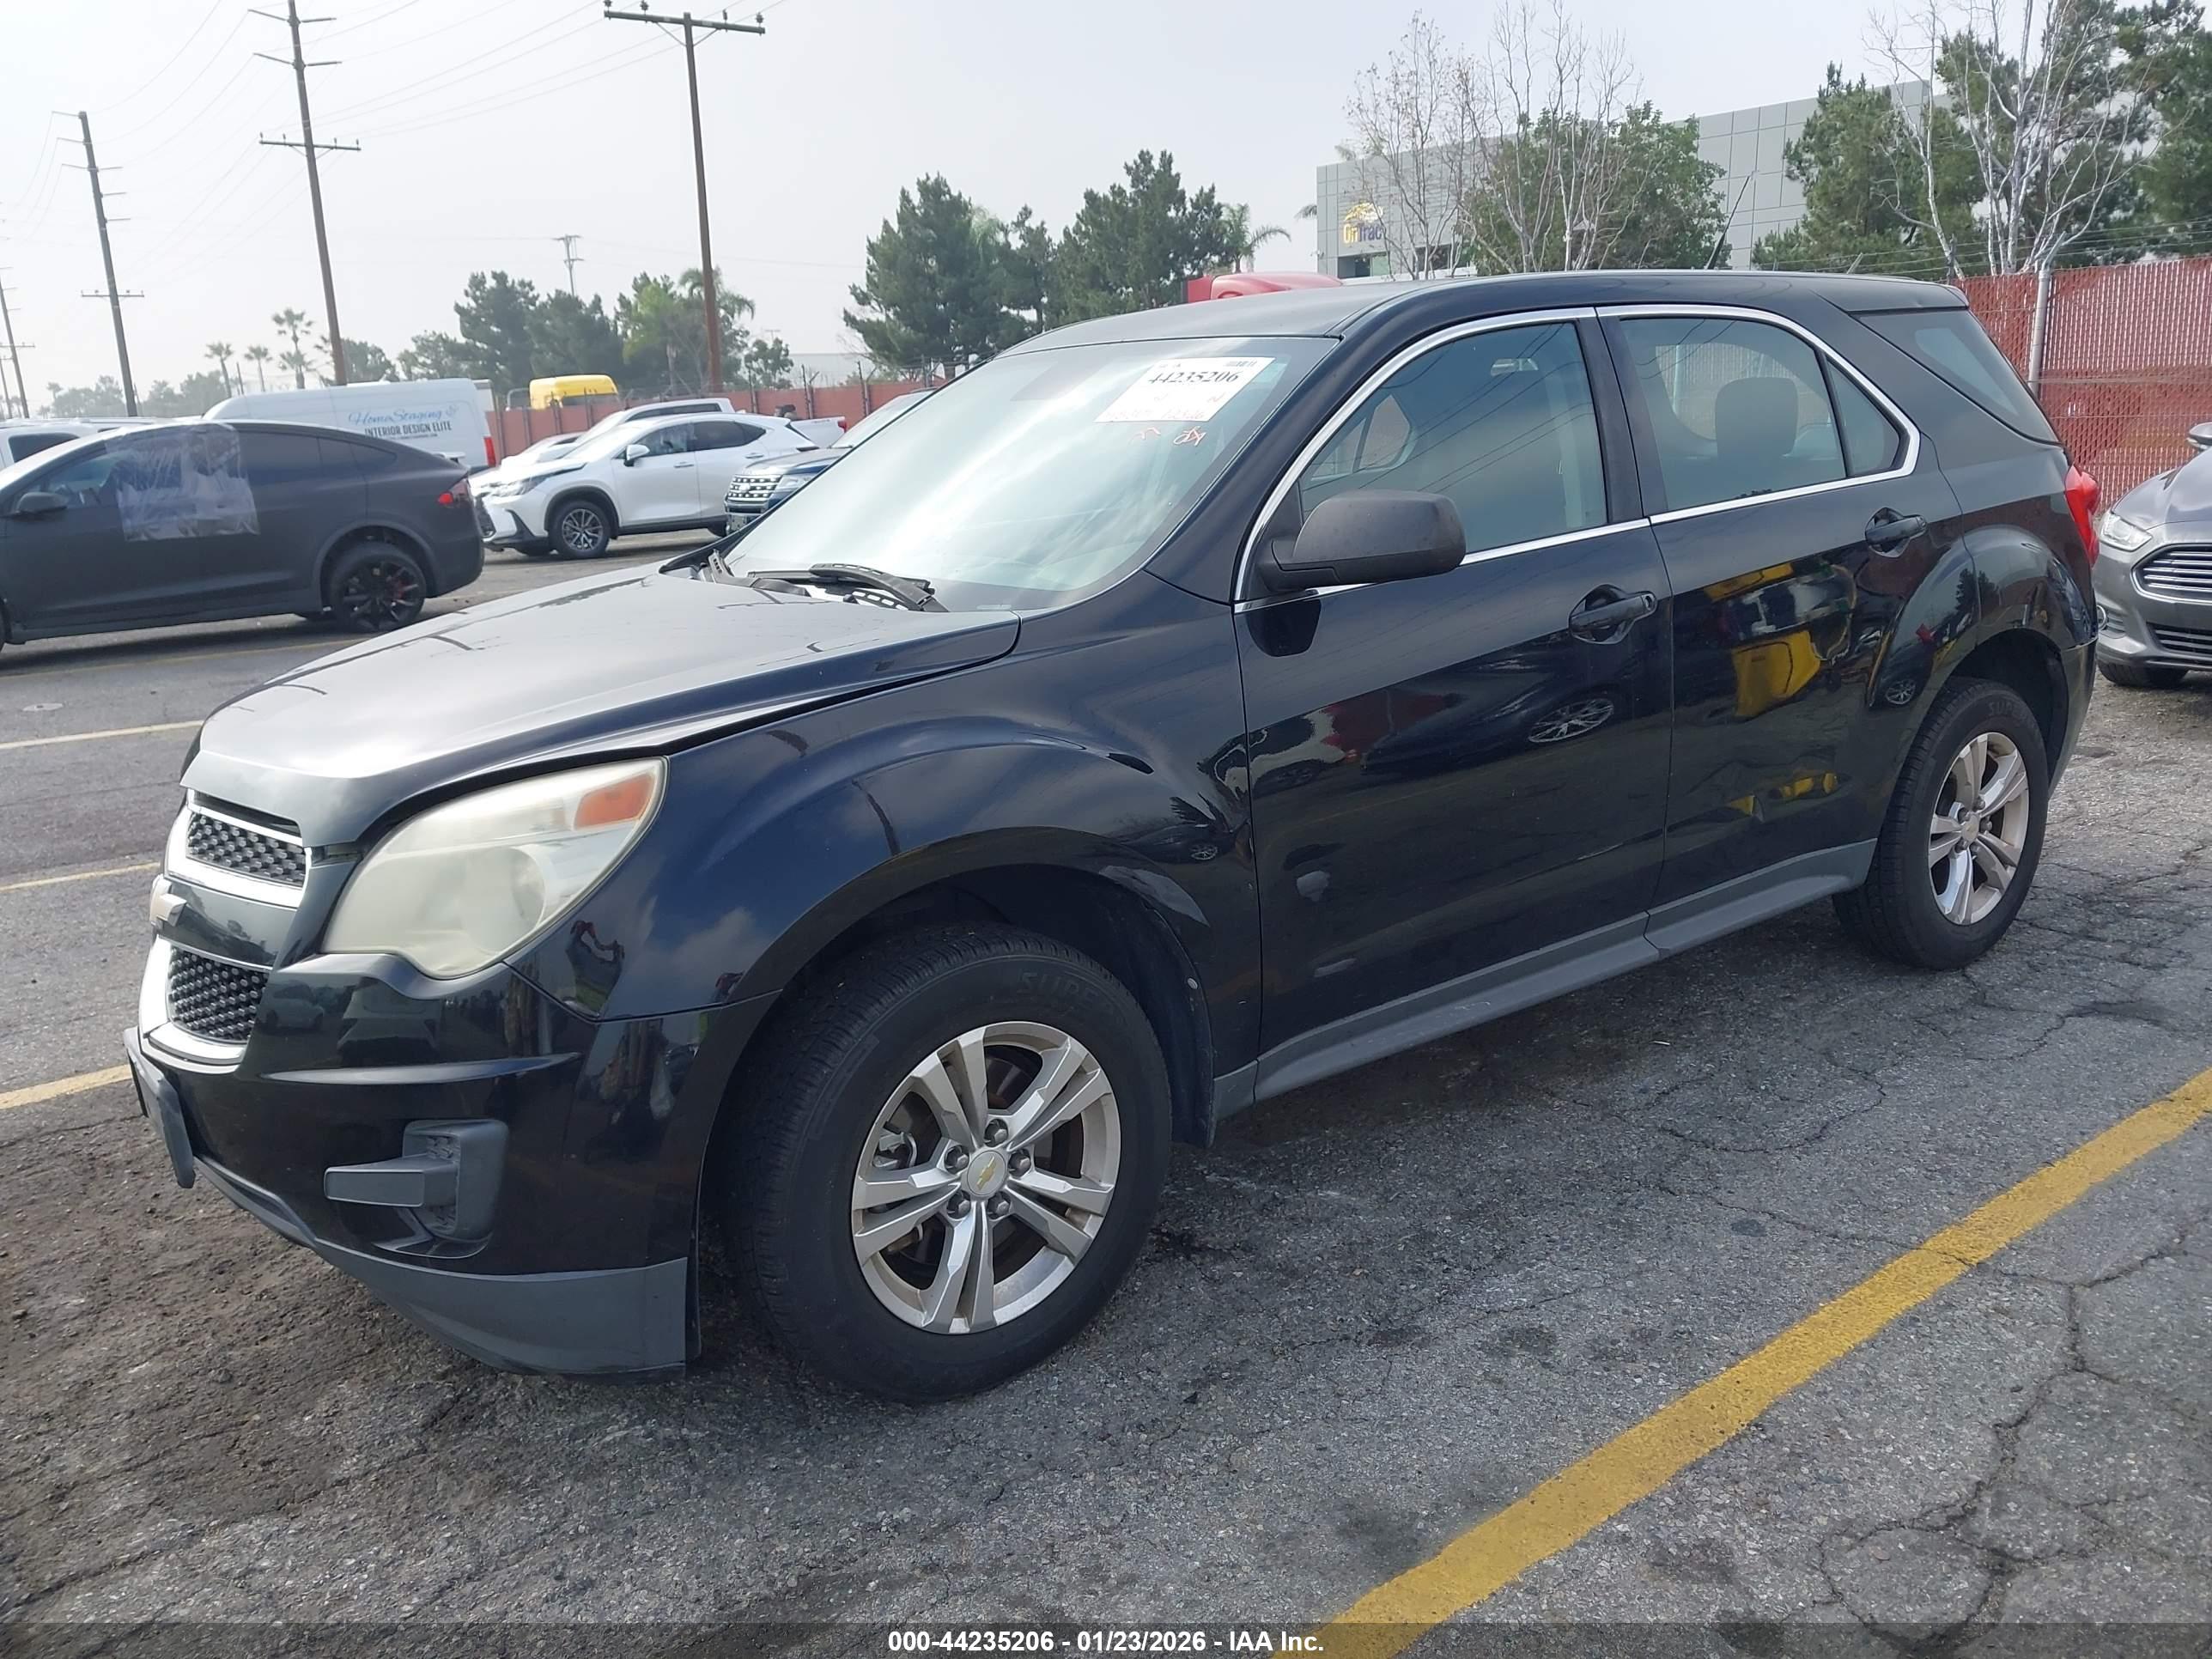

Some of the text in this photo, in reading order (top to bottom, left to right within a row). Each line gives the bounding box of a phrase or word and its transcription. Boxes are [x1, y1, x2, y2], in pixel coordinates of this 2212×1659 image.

[1148, 371, 1240, 384] 44235206
[364, 424, 402, 438] INTERIOR
[403, 422, 431, 434] DESIGN
[432, 421, 452, 432] ELITE
